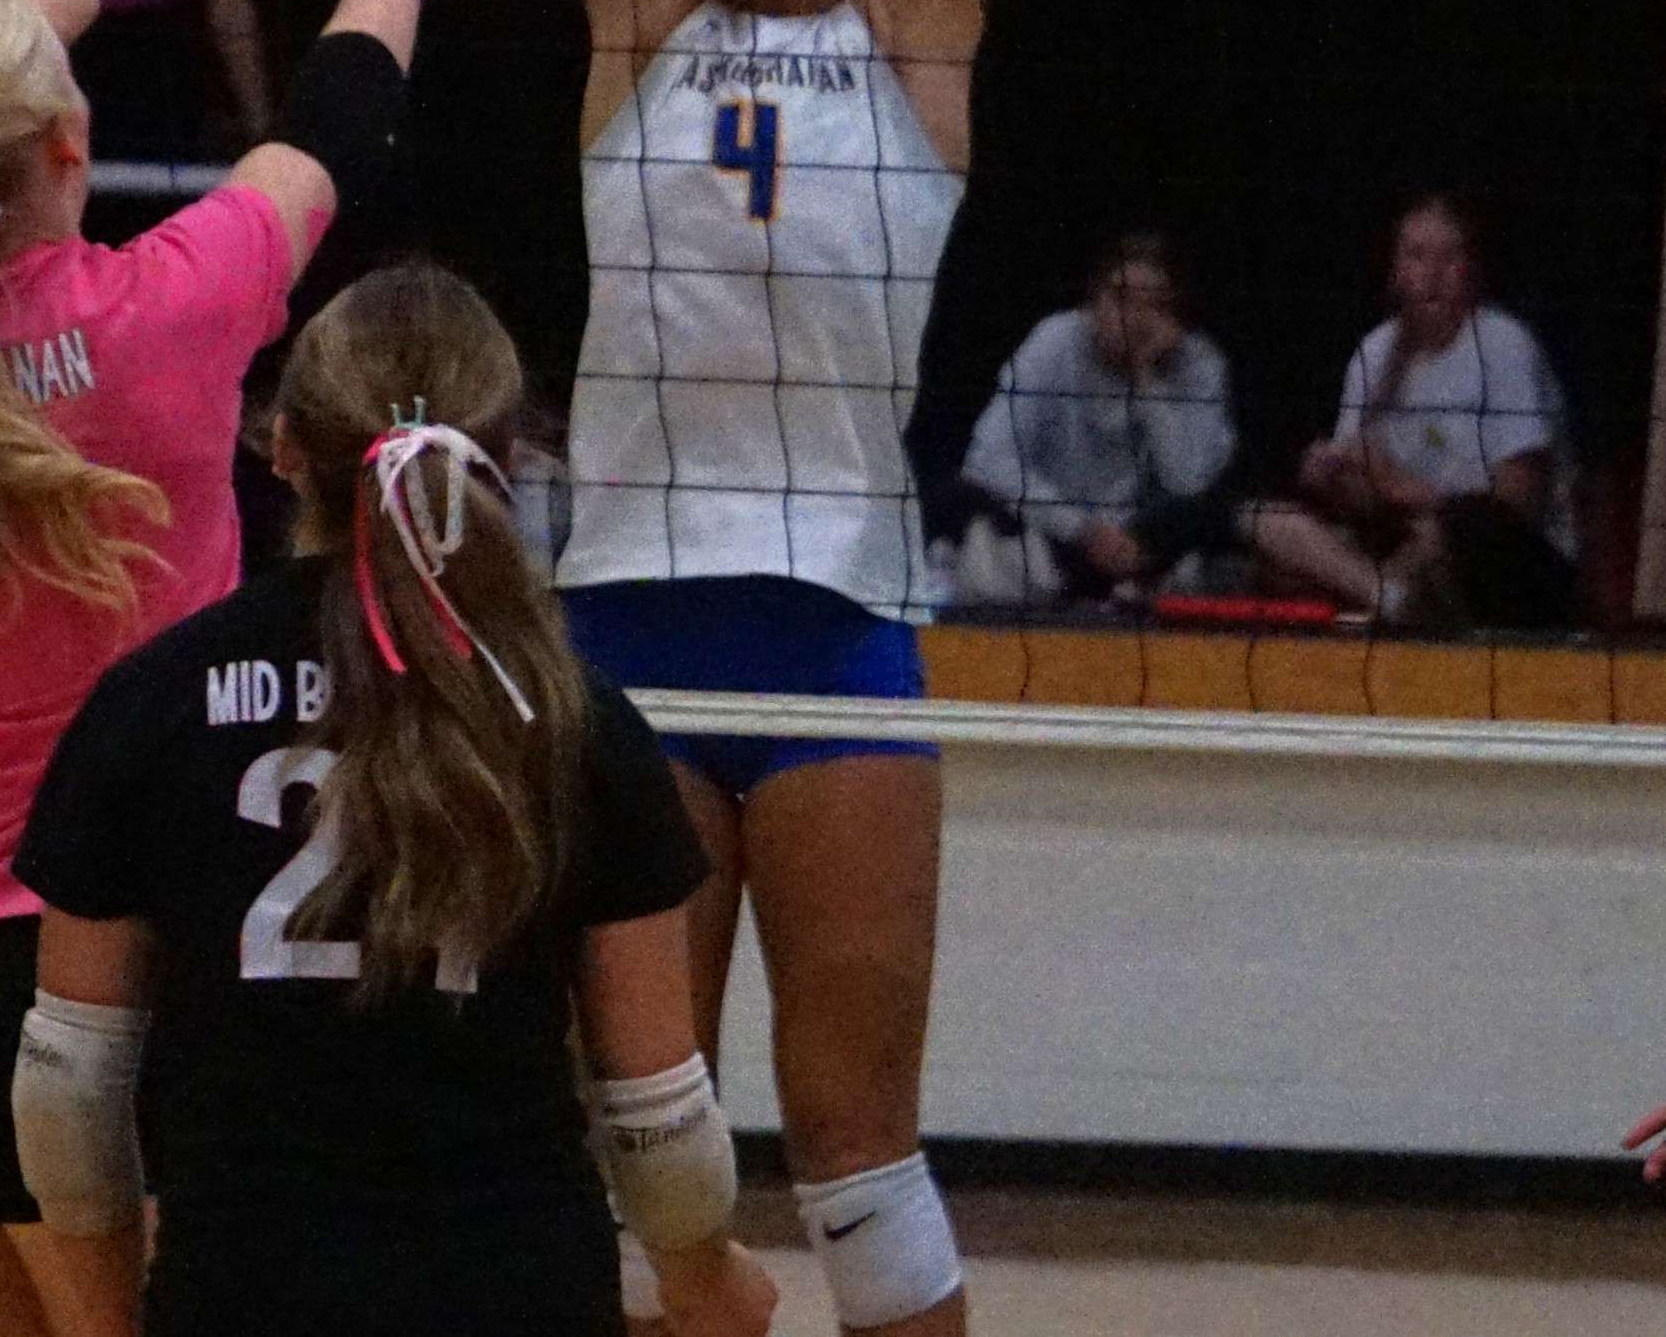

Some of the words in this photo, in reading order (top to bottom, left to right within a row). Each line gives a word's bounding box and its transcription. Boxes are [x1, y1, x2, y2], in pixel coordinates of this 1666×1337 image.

[713, 98, 783, 224] 4
[206, 659, 281, 727] MID
[296, 659, 333, 723] B
